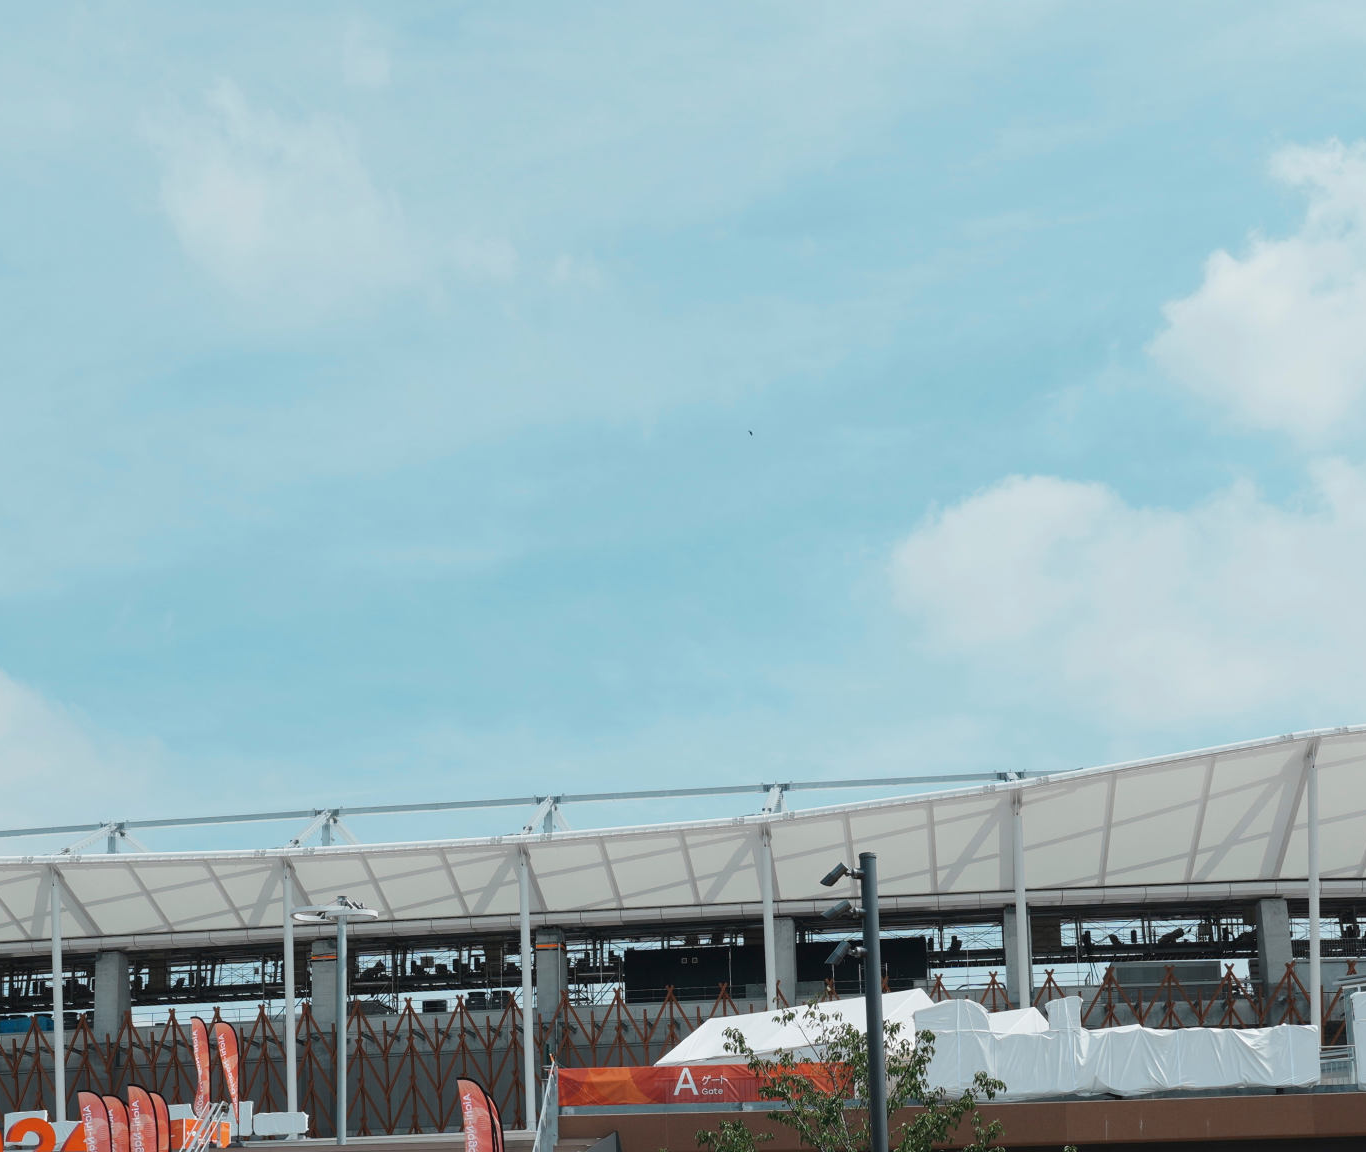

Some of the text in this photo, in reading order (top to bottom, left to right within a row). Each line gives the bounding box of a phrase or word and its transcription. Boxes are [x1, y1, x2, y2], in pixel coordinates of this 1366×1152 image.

[674, 1067, 699, 1096] A
[701, 1075, 724, 1086] ゲート
